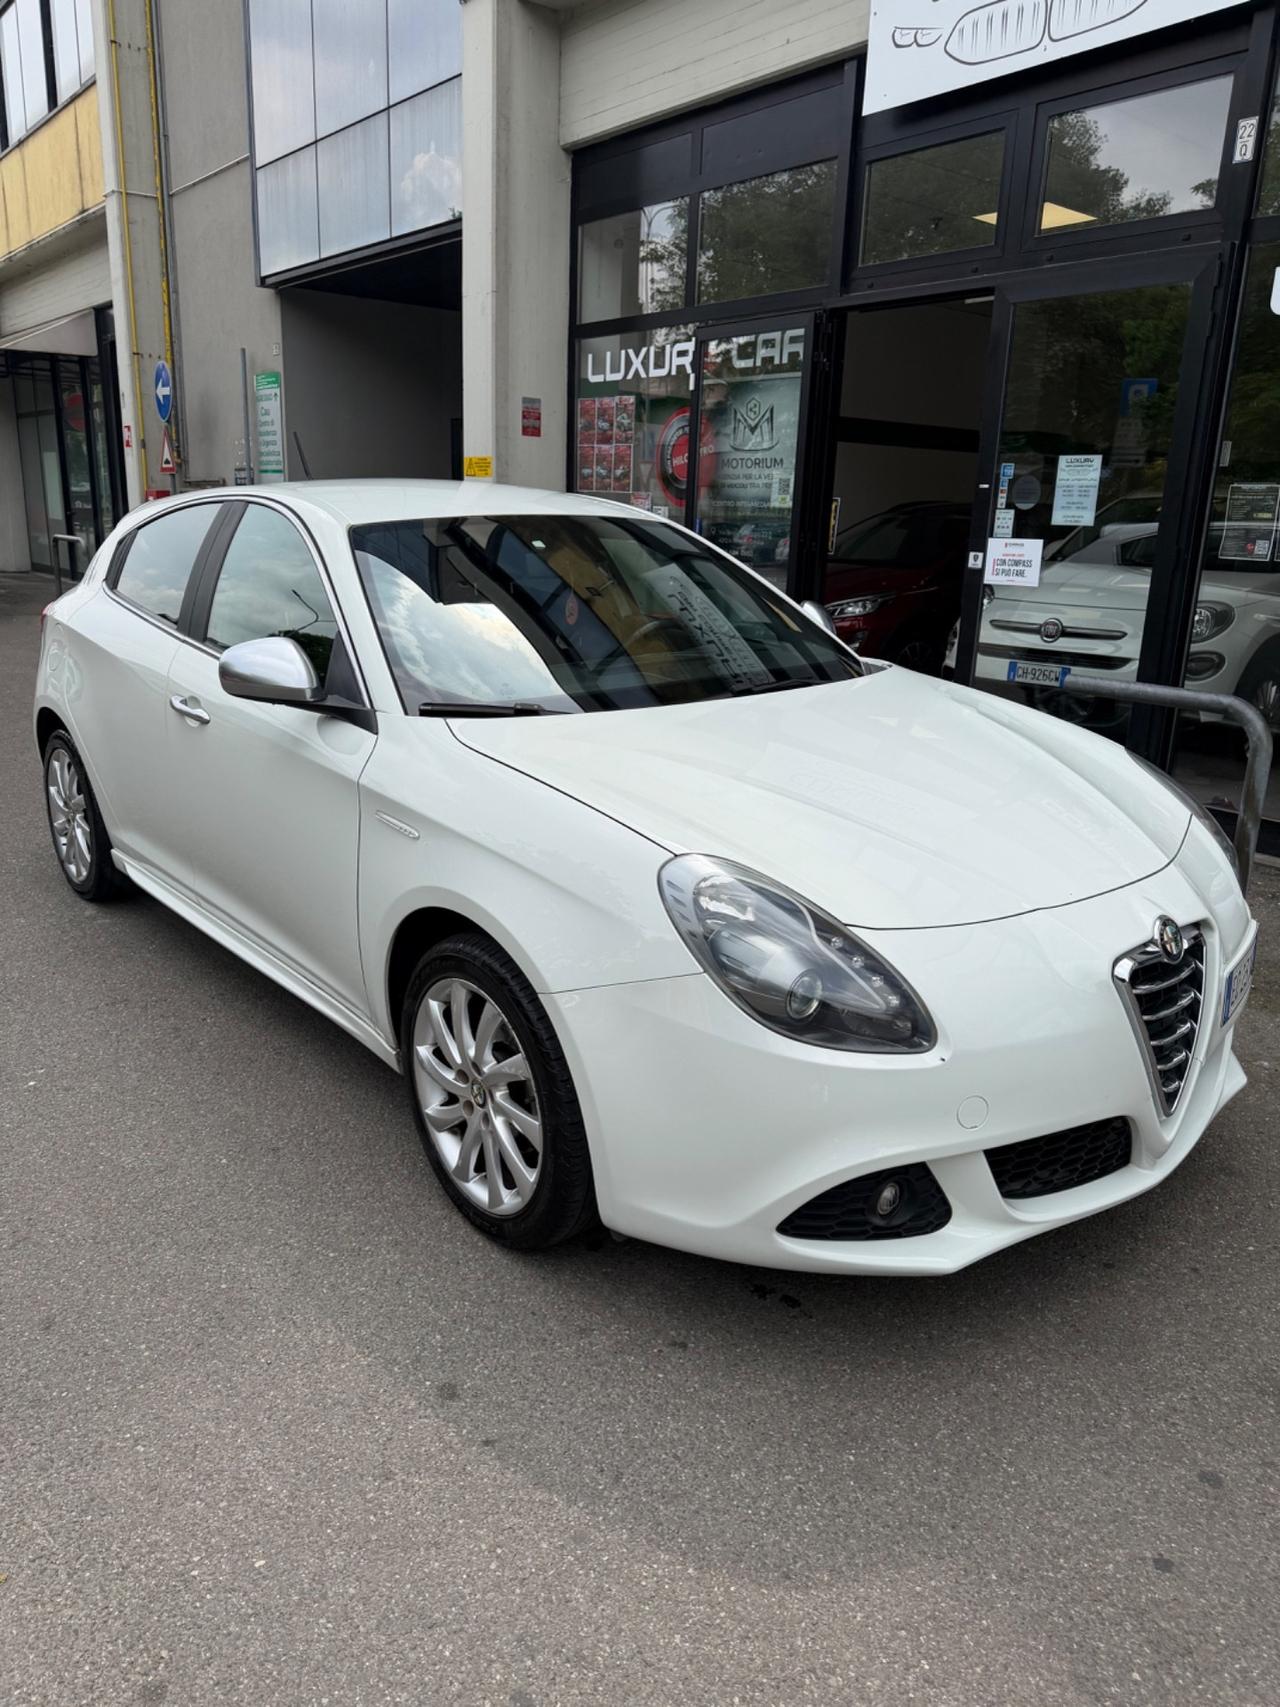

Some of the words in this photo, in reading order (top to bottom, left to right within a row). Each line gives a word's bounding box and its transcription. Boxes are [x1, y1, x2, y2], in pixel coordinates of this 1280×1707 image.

[1239, 123, 1255, 139] 22
[720, 456, 784, 471] MOTORIUM
[996, 558, 1007, 567] CON
[1008, 559, 1033, 568] COMPASS
